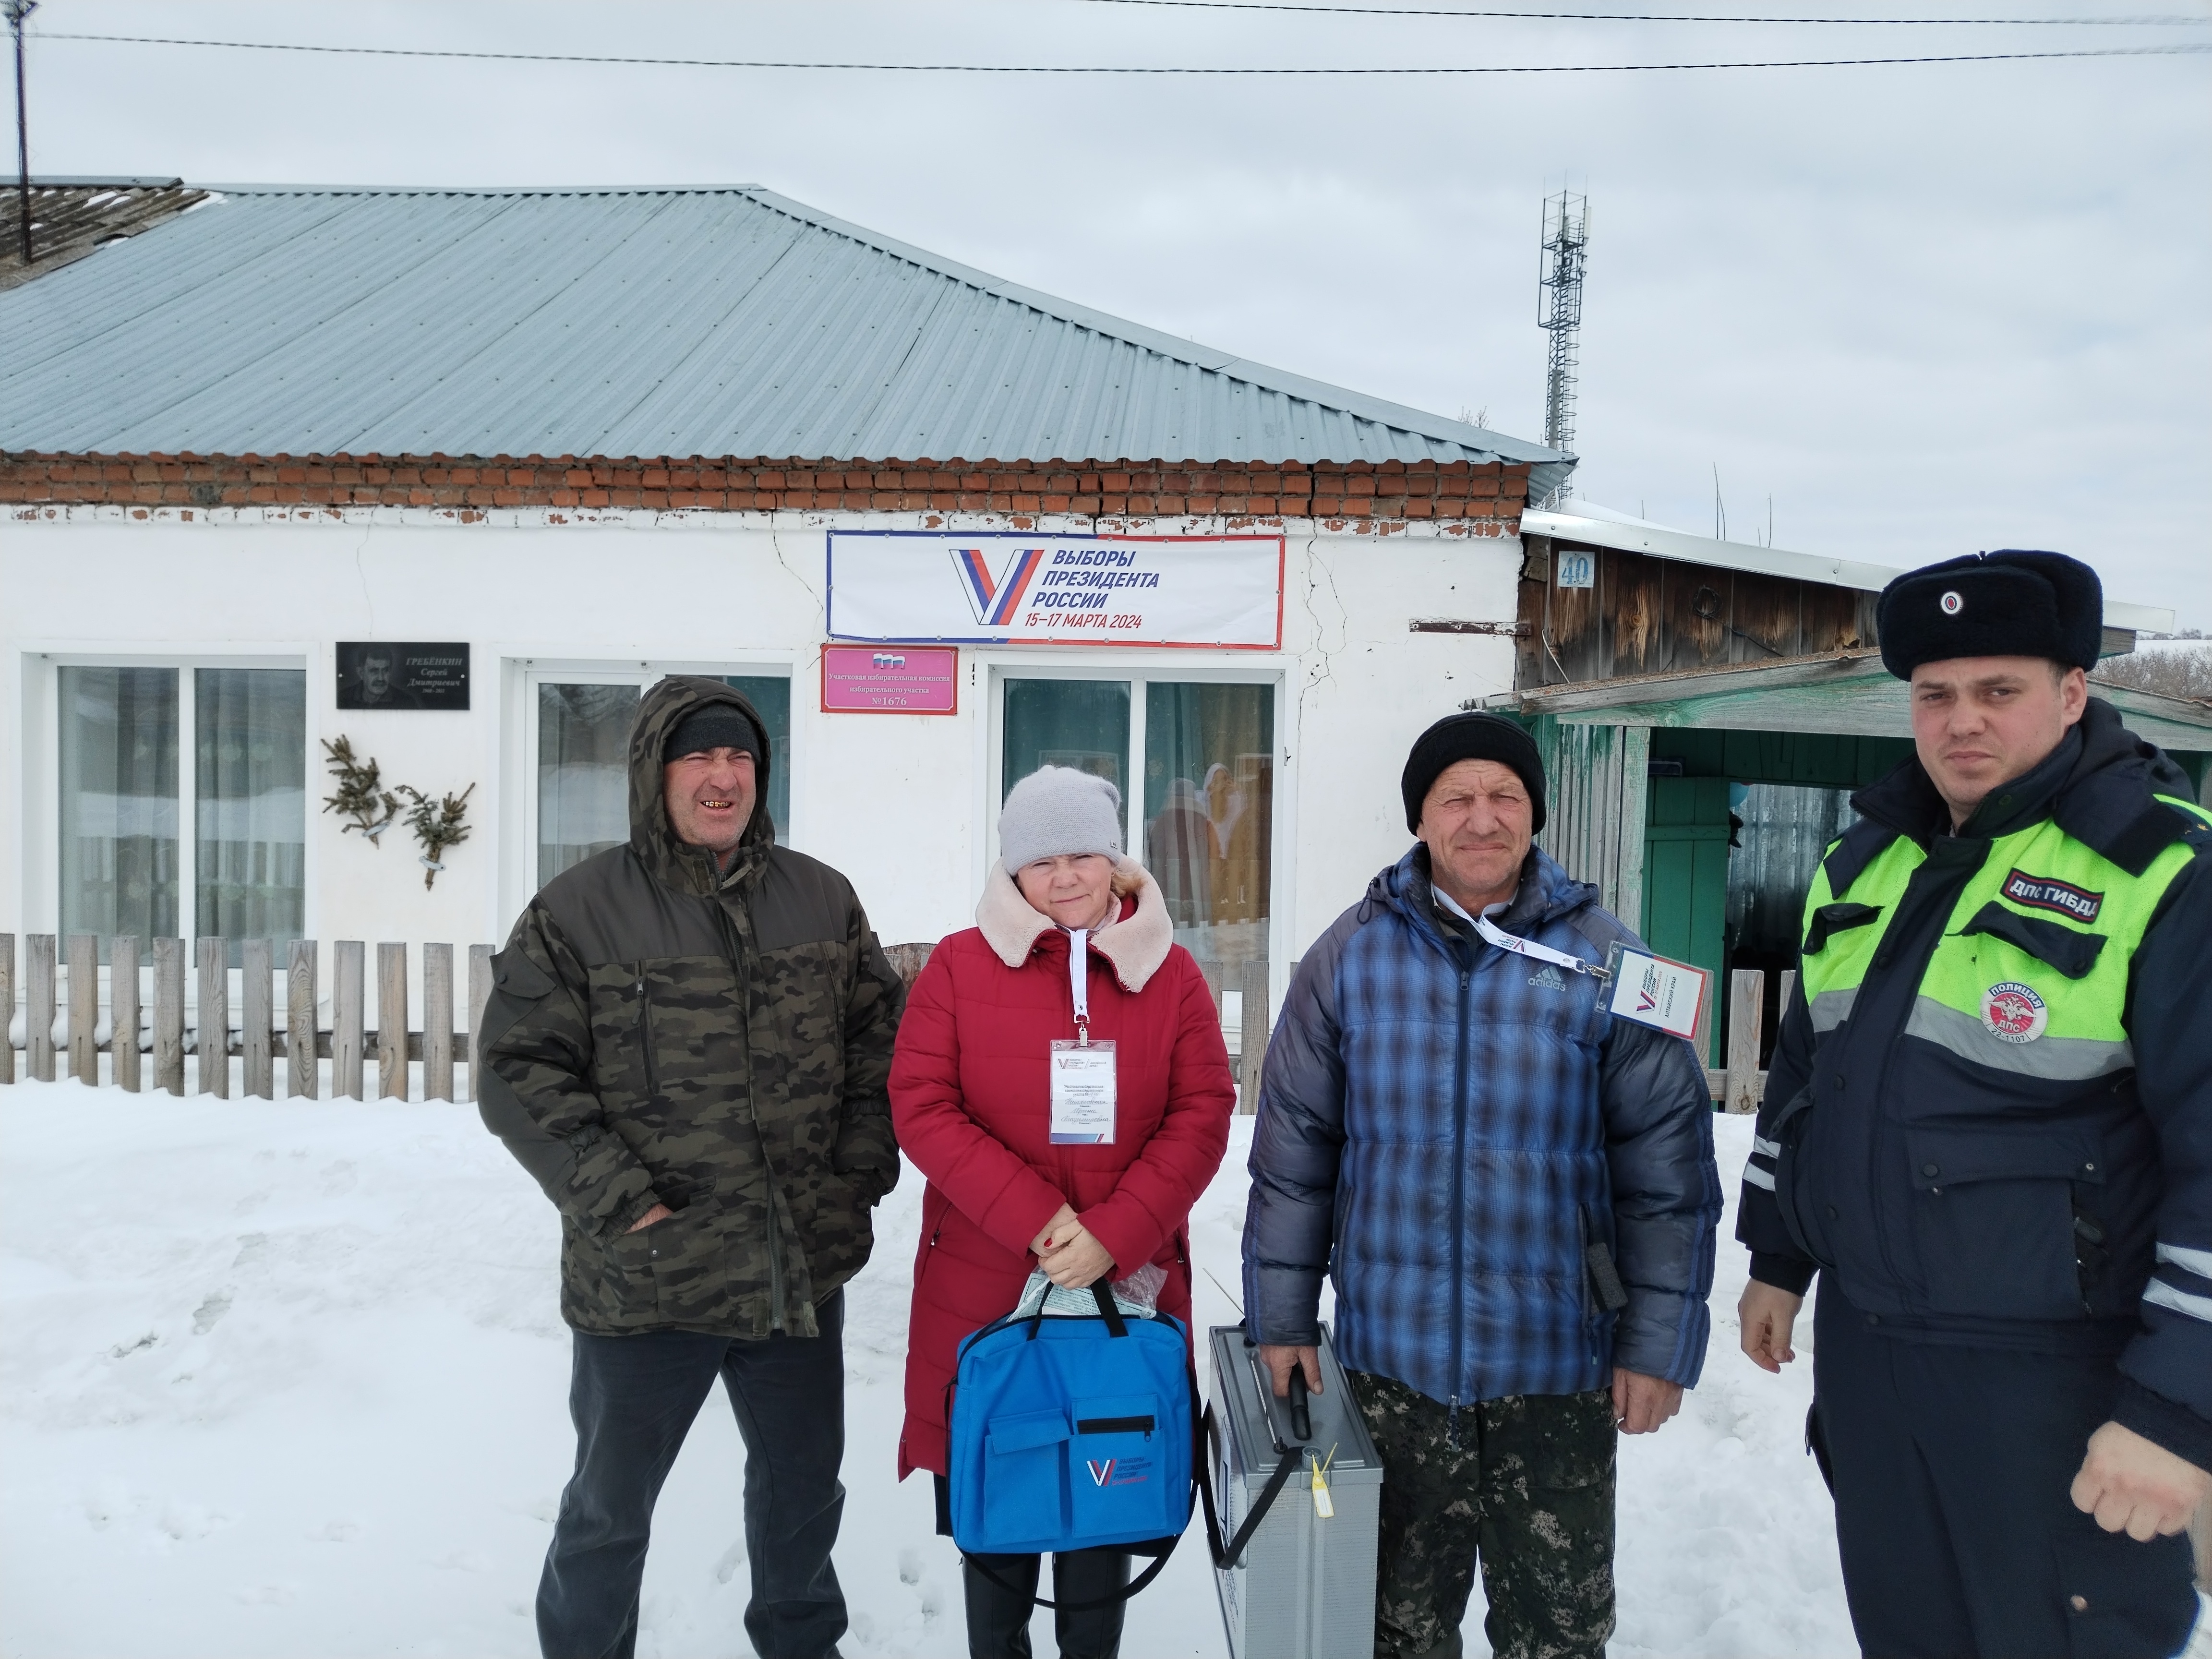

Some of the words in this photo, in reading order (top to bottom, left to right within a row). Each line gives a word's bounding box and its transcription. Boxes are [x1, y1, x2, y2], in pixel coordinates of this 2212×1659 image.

[1052, 550, 1136, 567] ВЫБОРЫ
[1562, 556, 1588, 585] 40
[1042, 570, 1160, 589] ПРЕЗИДЕНТА
[1031, 592, 1109, 609] РОССИИ
[1061, 613, 1106, 628] МАРТА
[1109, 615, 1142, 629] 2024
[421, 667, 448, 678] Сергей
[867, 673, 917, 682] избирательная
[407, 677, 461, 688] Дмитриевич
[871, 697, 907, 706] №1676
[2009, 879, 2042, 899] ДПС
[1527, 977, 1566, 991] adidas
[1646, 963, 1655, 993] ПРЕЗИДЕНТА
[1665, 989, 1674, 1018] АЛТАЙСКИЙ
[1991, 983, 2043, 1008] ПОЛИЦИЯ
[1997, 1019, 2020, 1033] ДПС
[1991, 1028, 2025, 1042] 22-1107
